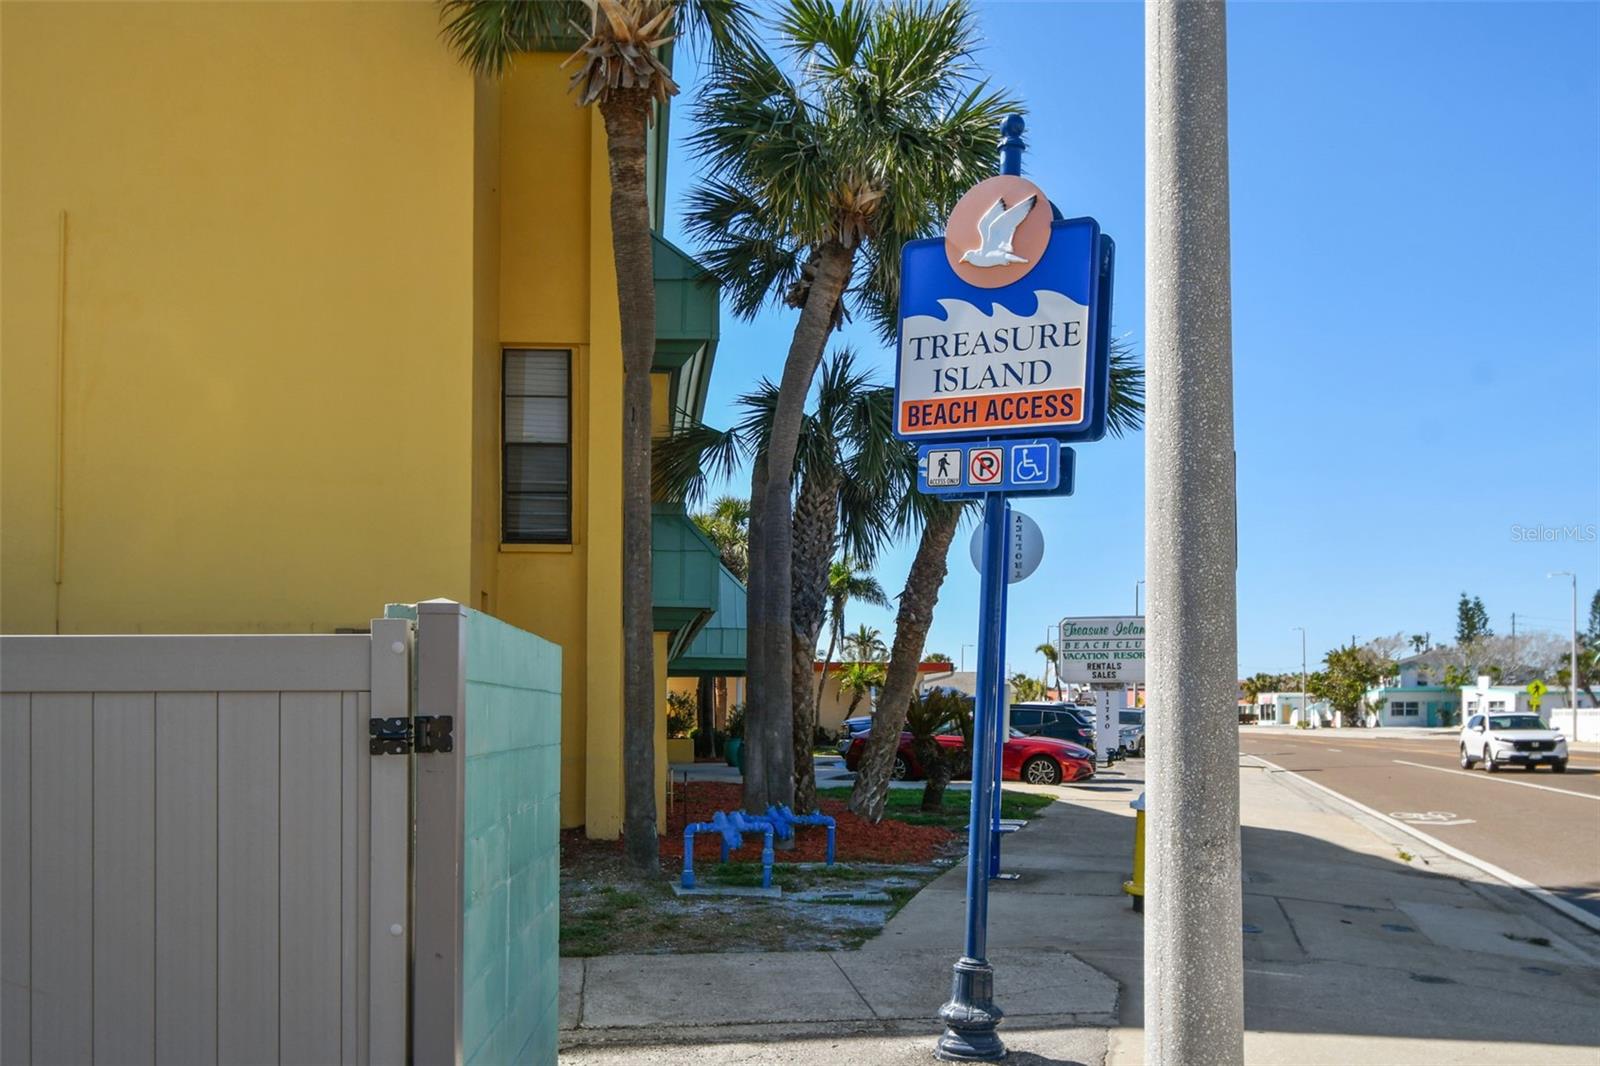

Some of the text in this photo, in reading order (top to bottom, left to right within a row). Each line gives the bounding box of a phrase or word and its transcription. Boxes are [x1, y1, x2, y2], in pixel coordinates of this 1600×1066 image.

[909, 321, 1081, 361] TREASURE
[933, 359, 1052, 393] ISLAND
[908, 393, 1074, 427] BEACH ACCESS
[1014, 516, 1023, 578] TROLLEY
[1063, 621, 1146, 637] Treasure Islan
[1064, 641, 1142, 649] BEACH CLU
[1063, 651, 1146, 660] VACATION RESOR
[1087, 662, 1122, 671] RENTALS
[1092, 671, 1117, 679] SALES
